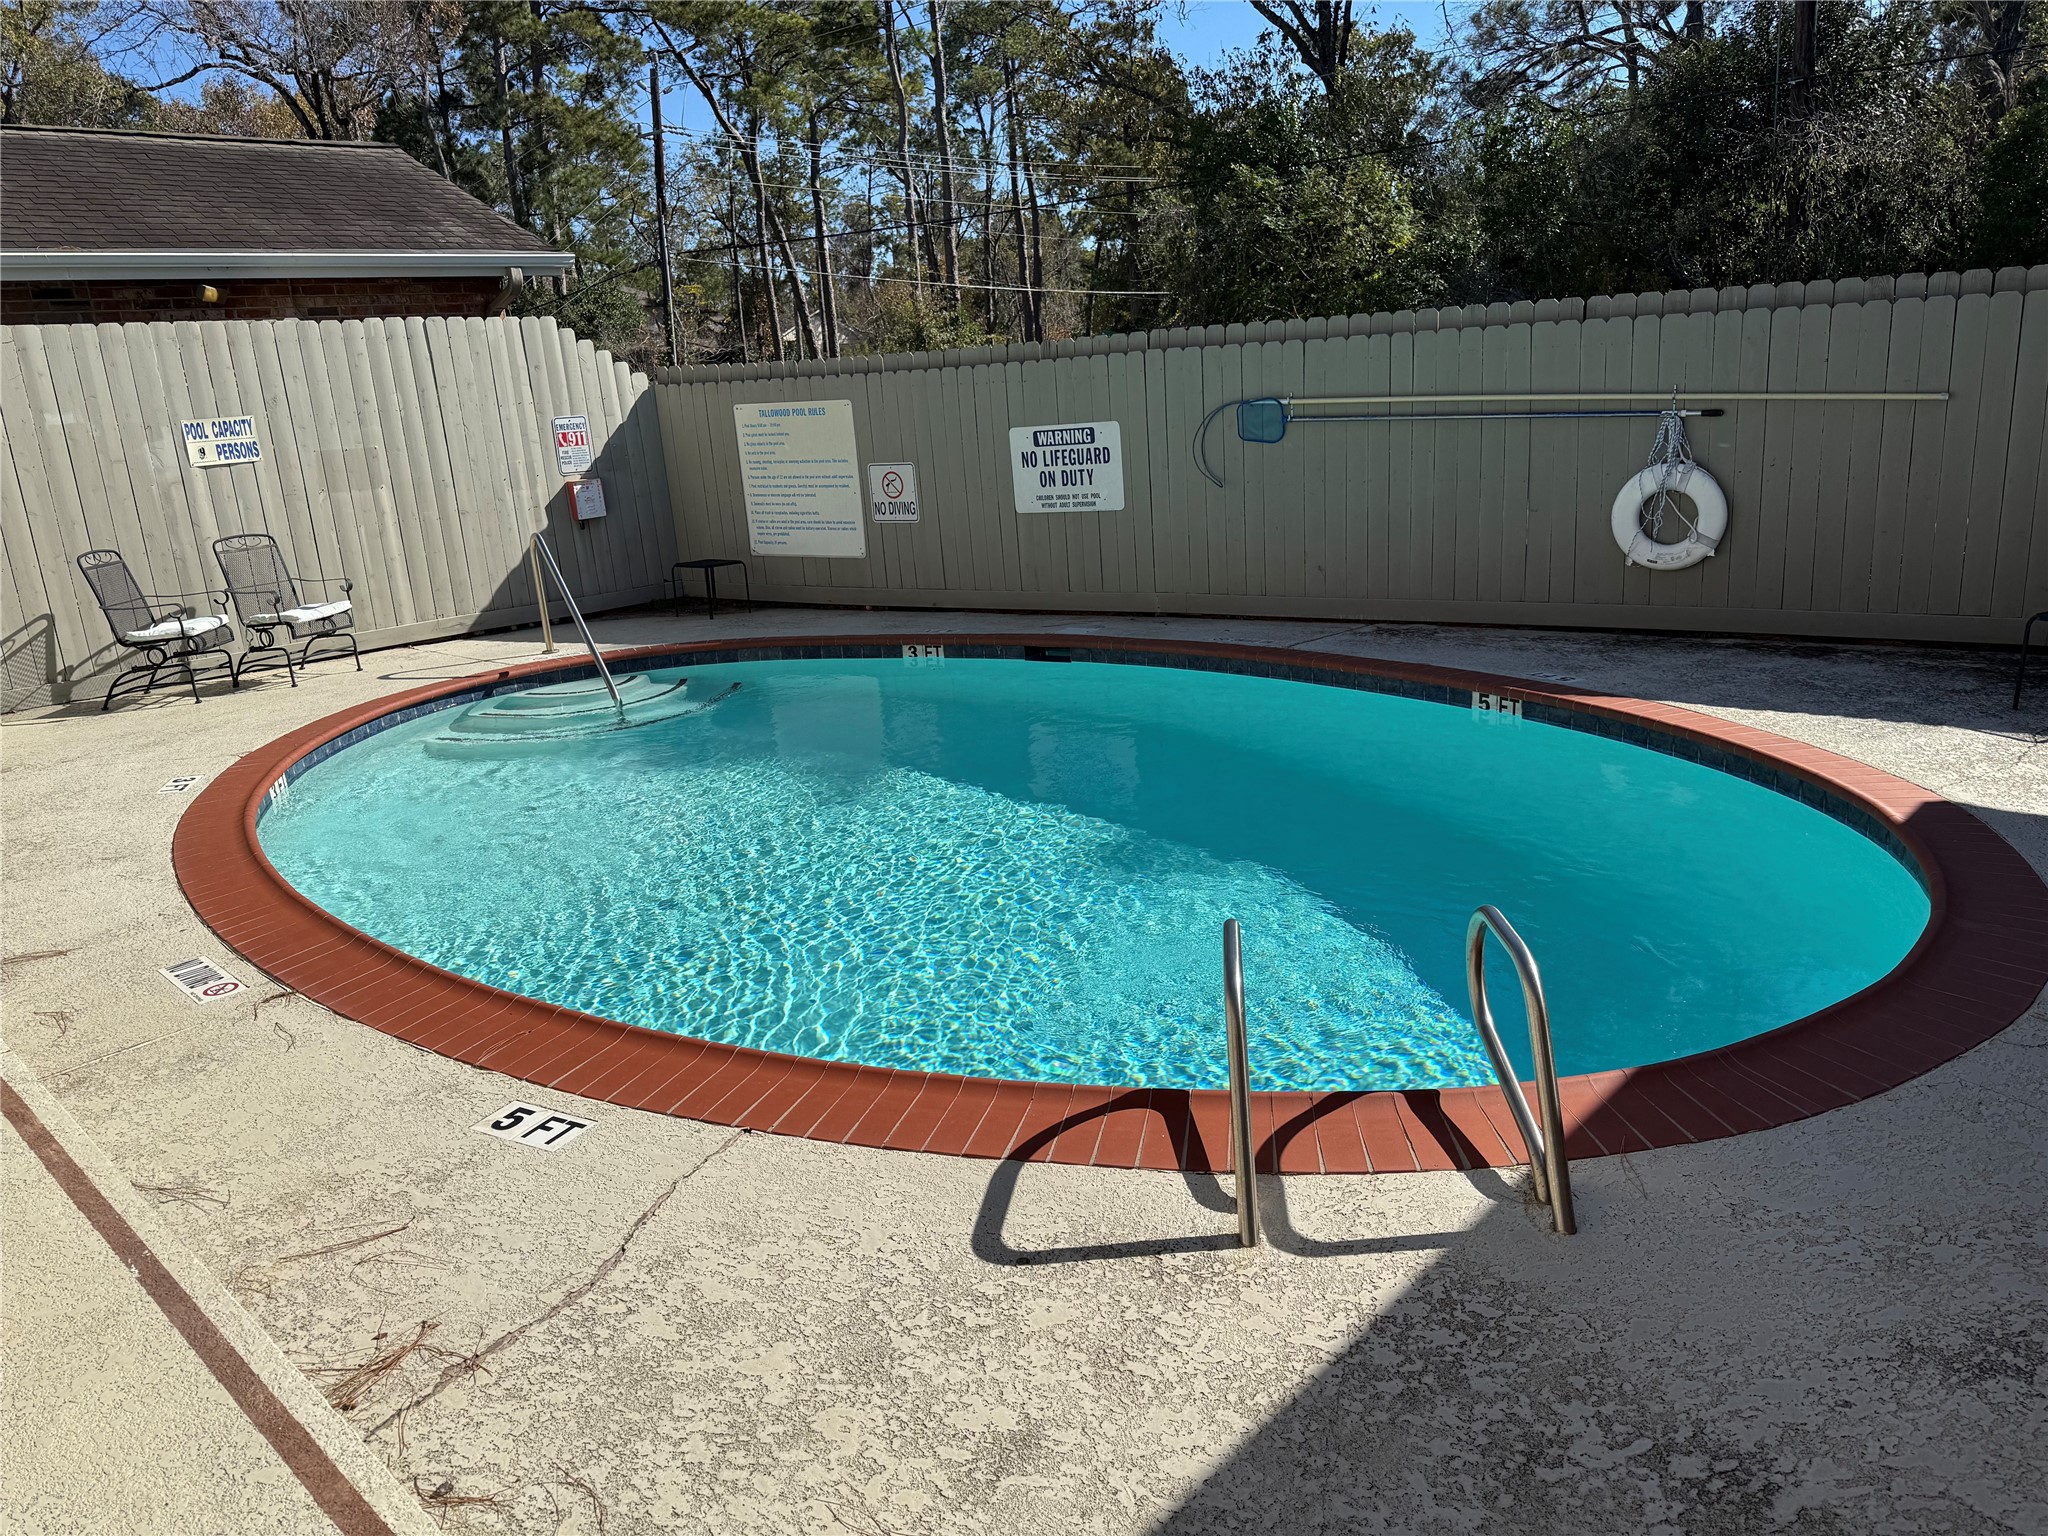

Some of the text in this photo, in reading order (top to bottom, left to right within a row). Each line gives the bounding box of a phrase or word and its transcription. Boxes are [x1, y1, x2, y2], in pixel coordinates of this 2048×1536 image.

[758, 407, 826, 418] TALLOWOOD POOL RULES
[183, 418, 253, 440] POOL CAPACITY
[555, 422, 585, 431] EMERGENCY
[568, 431, 587, 447] 911
[1036, 428, 1092, 446] WARNING
[215, 440, 260, 460] PERSONS
[1021, 446, 1111, 469] NO LIFEGUARD
[1039, 468, 1094, 488] ON DUTY
[874, 501, 916, 515] NO DIVING
[908, 645, 942, 658] 3 FT
[1478, 693, 1520, 716] 5 FT
[159, 783, 190, 793] FT
[490, 1106, 588, 1145] 5 FT
